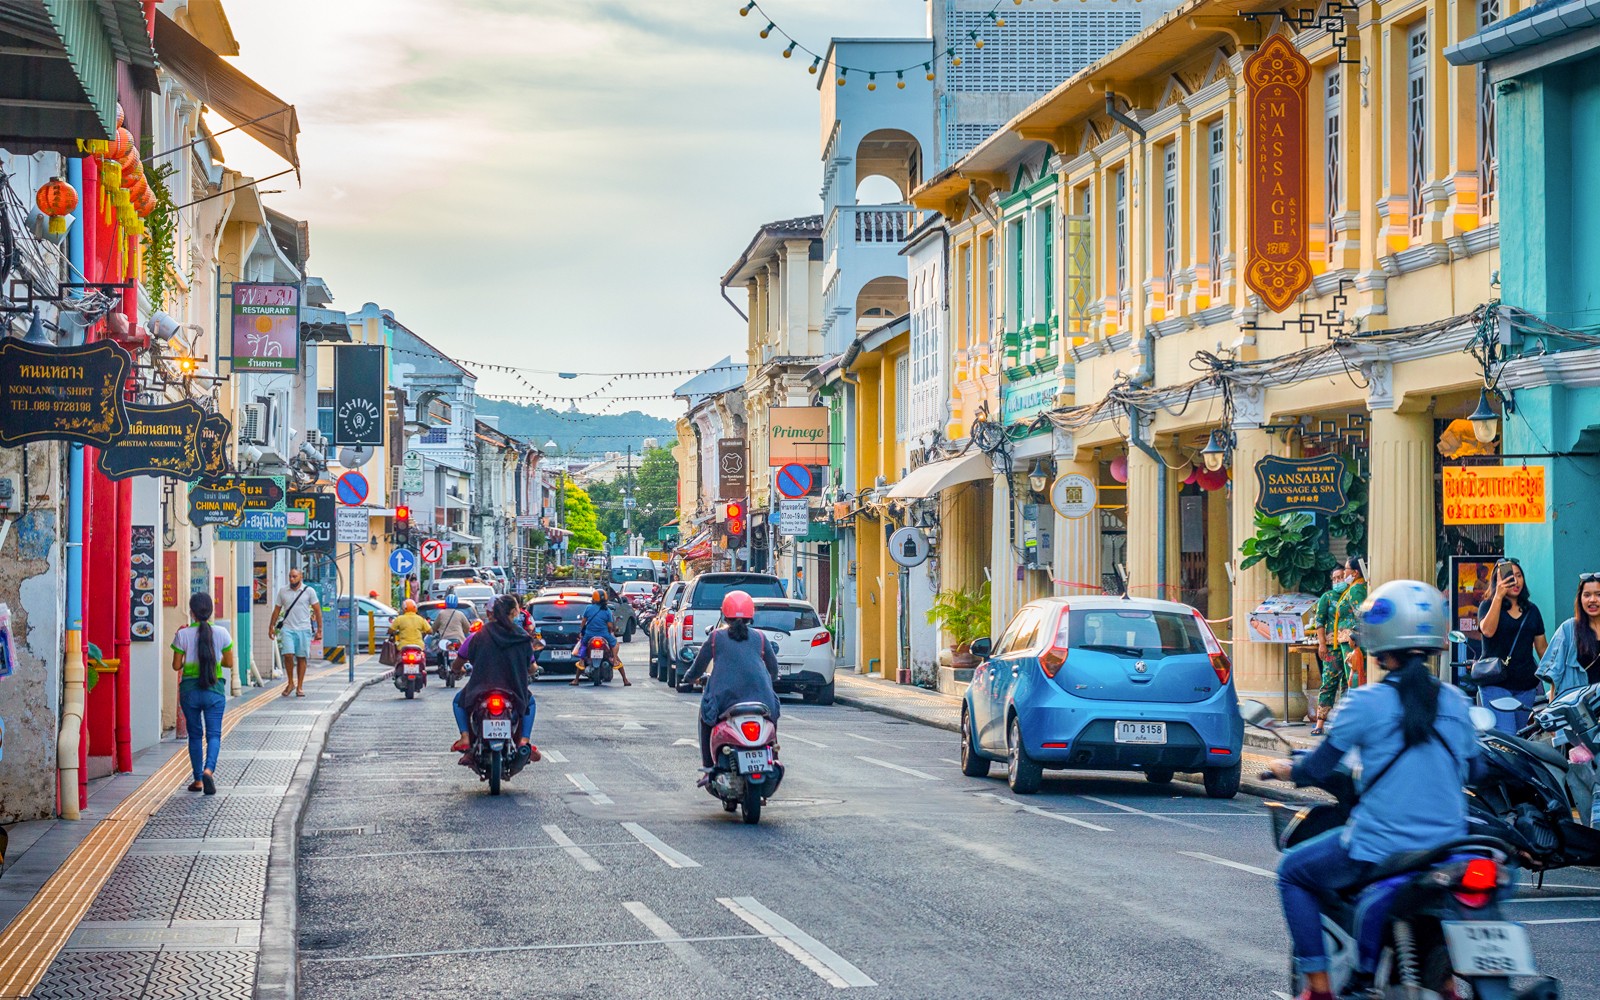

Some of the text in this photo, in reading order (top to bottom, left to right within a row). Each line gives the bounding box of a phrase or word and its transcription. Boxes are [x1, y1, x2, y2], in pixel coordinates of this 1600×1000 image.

[1270, 103, 1285, 235] MASSAGE
[1289, 207, 1297, 236] SPA
[242, 306, 290, 314] RESTAURANT
[247, 358, 282, 367] ร้านอาหาร
[19, 364, 85, 379] หนนหลาง
[9, 385, 55, 395] NONLANG
[339, 398, 380, 418] CHINO
[772, 425, 824, 441] Primego
[1269, 473, 1335, 485] SANSABAI
[1269, 485, 1335, 494] MASSAGE & SPA
[196, 501, 237, 511] CHINA INN
[781, 512, 807, 520] 07.00-19.00
[246, 531, 267, 541] HERBS
[268, 531, 285, 540] SHOP
[1140, 724, 1162, 734] 8158
